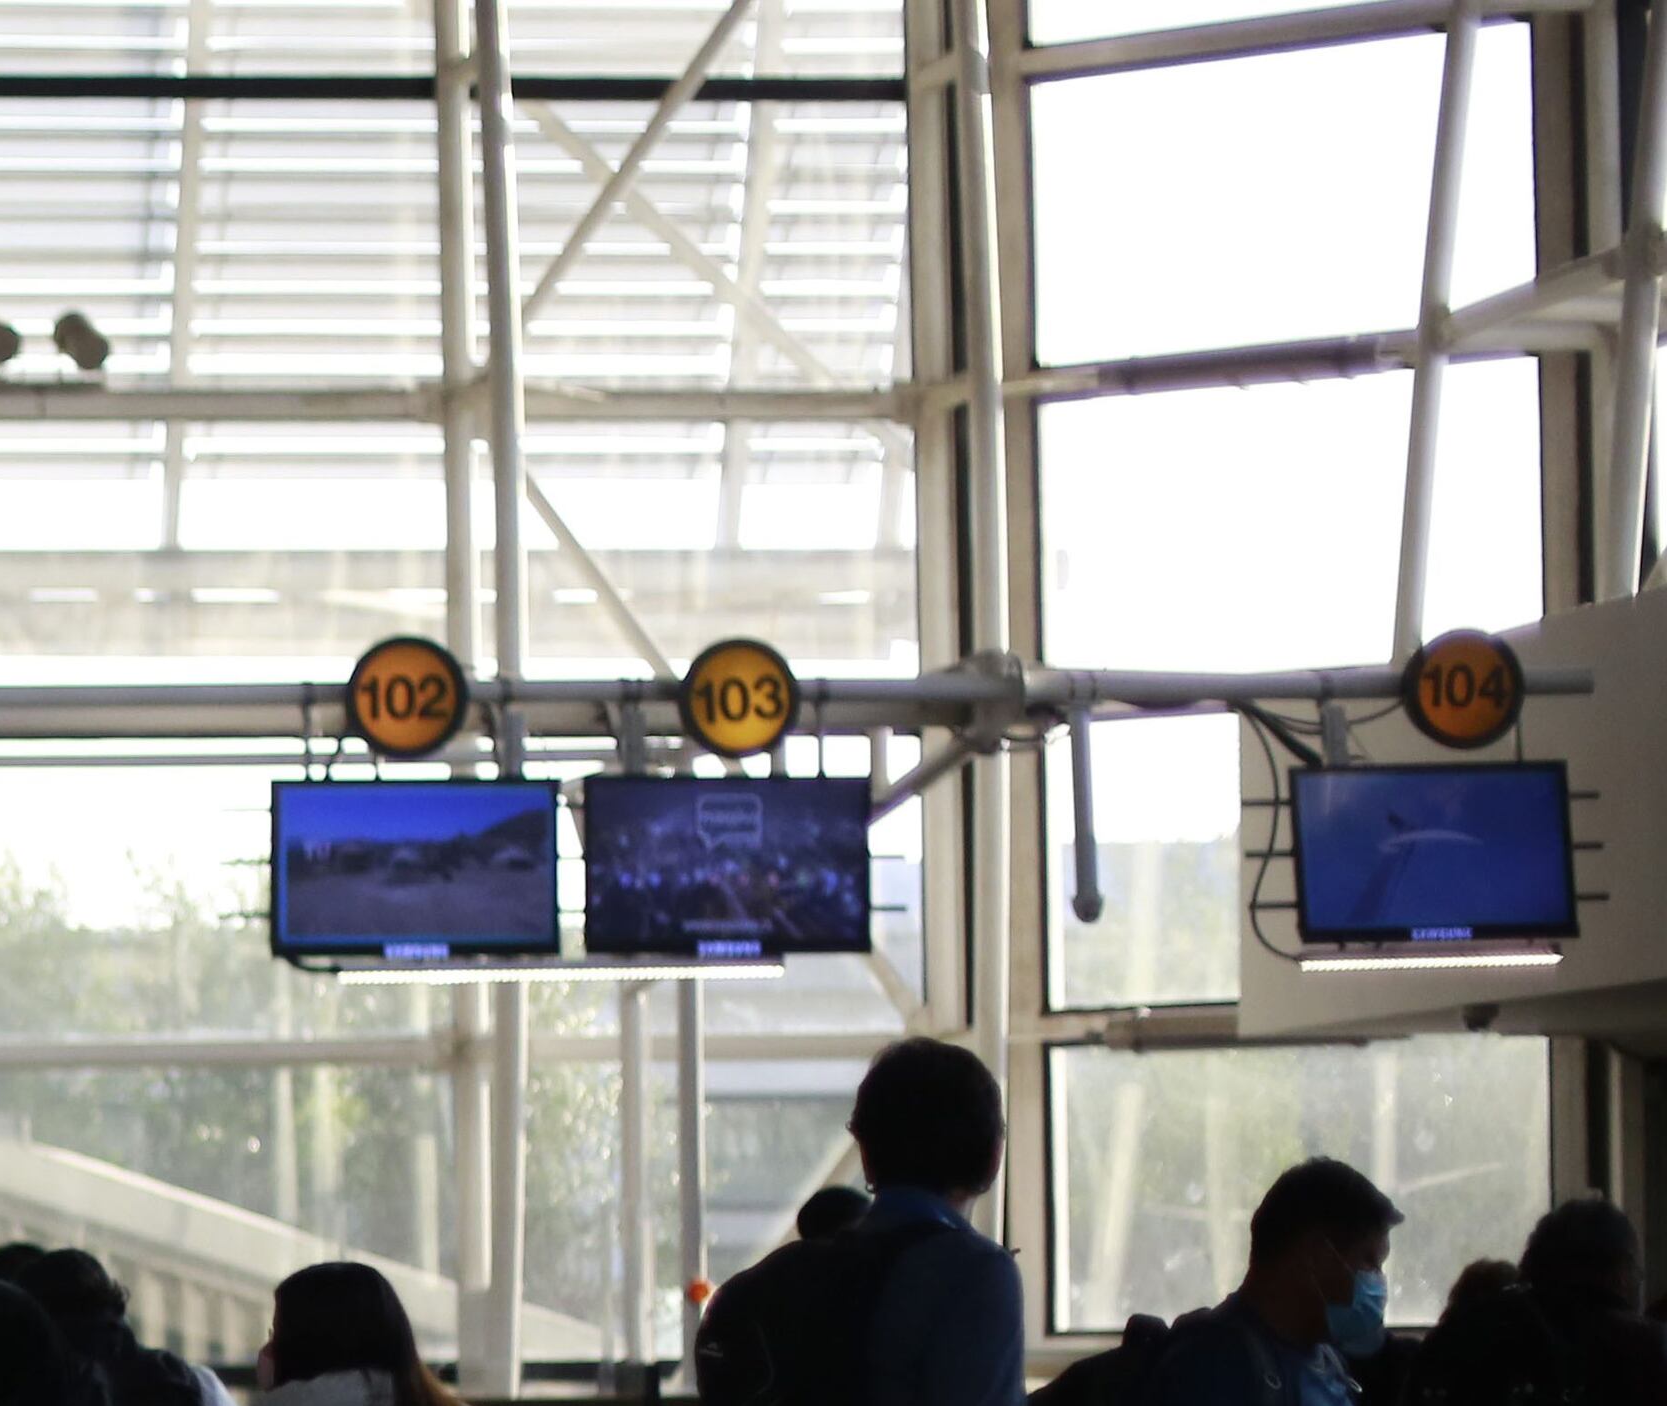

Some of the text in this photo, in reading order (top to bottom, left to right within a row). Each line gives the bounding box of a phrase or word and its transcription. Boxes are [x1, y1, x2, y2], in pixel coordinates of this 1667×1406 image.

[359, 673, 451, 722] 102
[699, 674, 789, 724] 103
[1422, 662, 1509, 710] 104
